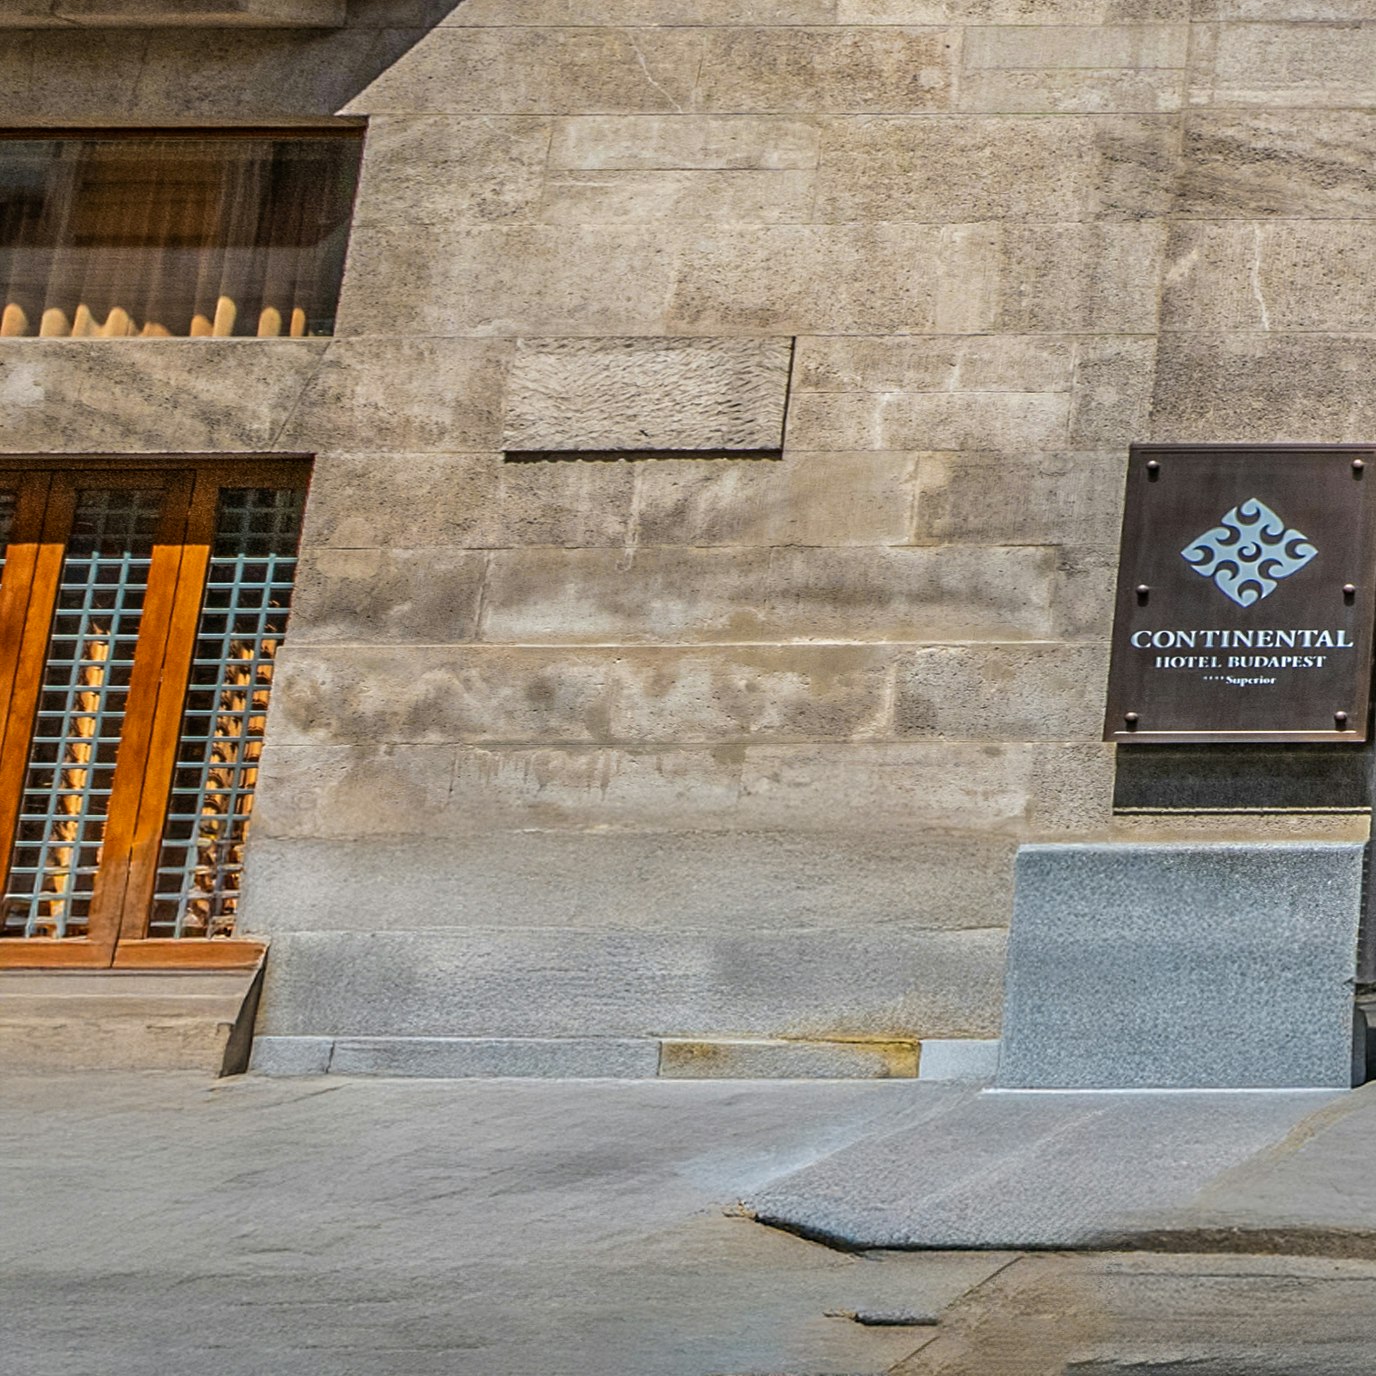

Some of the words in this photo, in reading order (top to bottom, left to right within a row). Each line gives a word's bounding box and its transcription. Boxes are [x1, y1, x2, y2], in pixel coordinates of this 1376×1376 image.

[1130, 629, 1354, 649] CONTINENTAL
[1155, 655, 1222, 669] HOTEL
[1227, 655, 1327, 669] BUDAPEST
